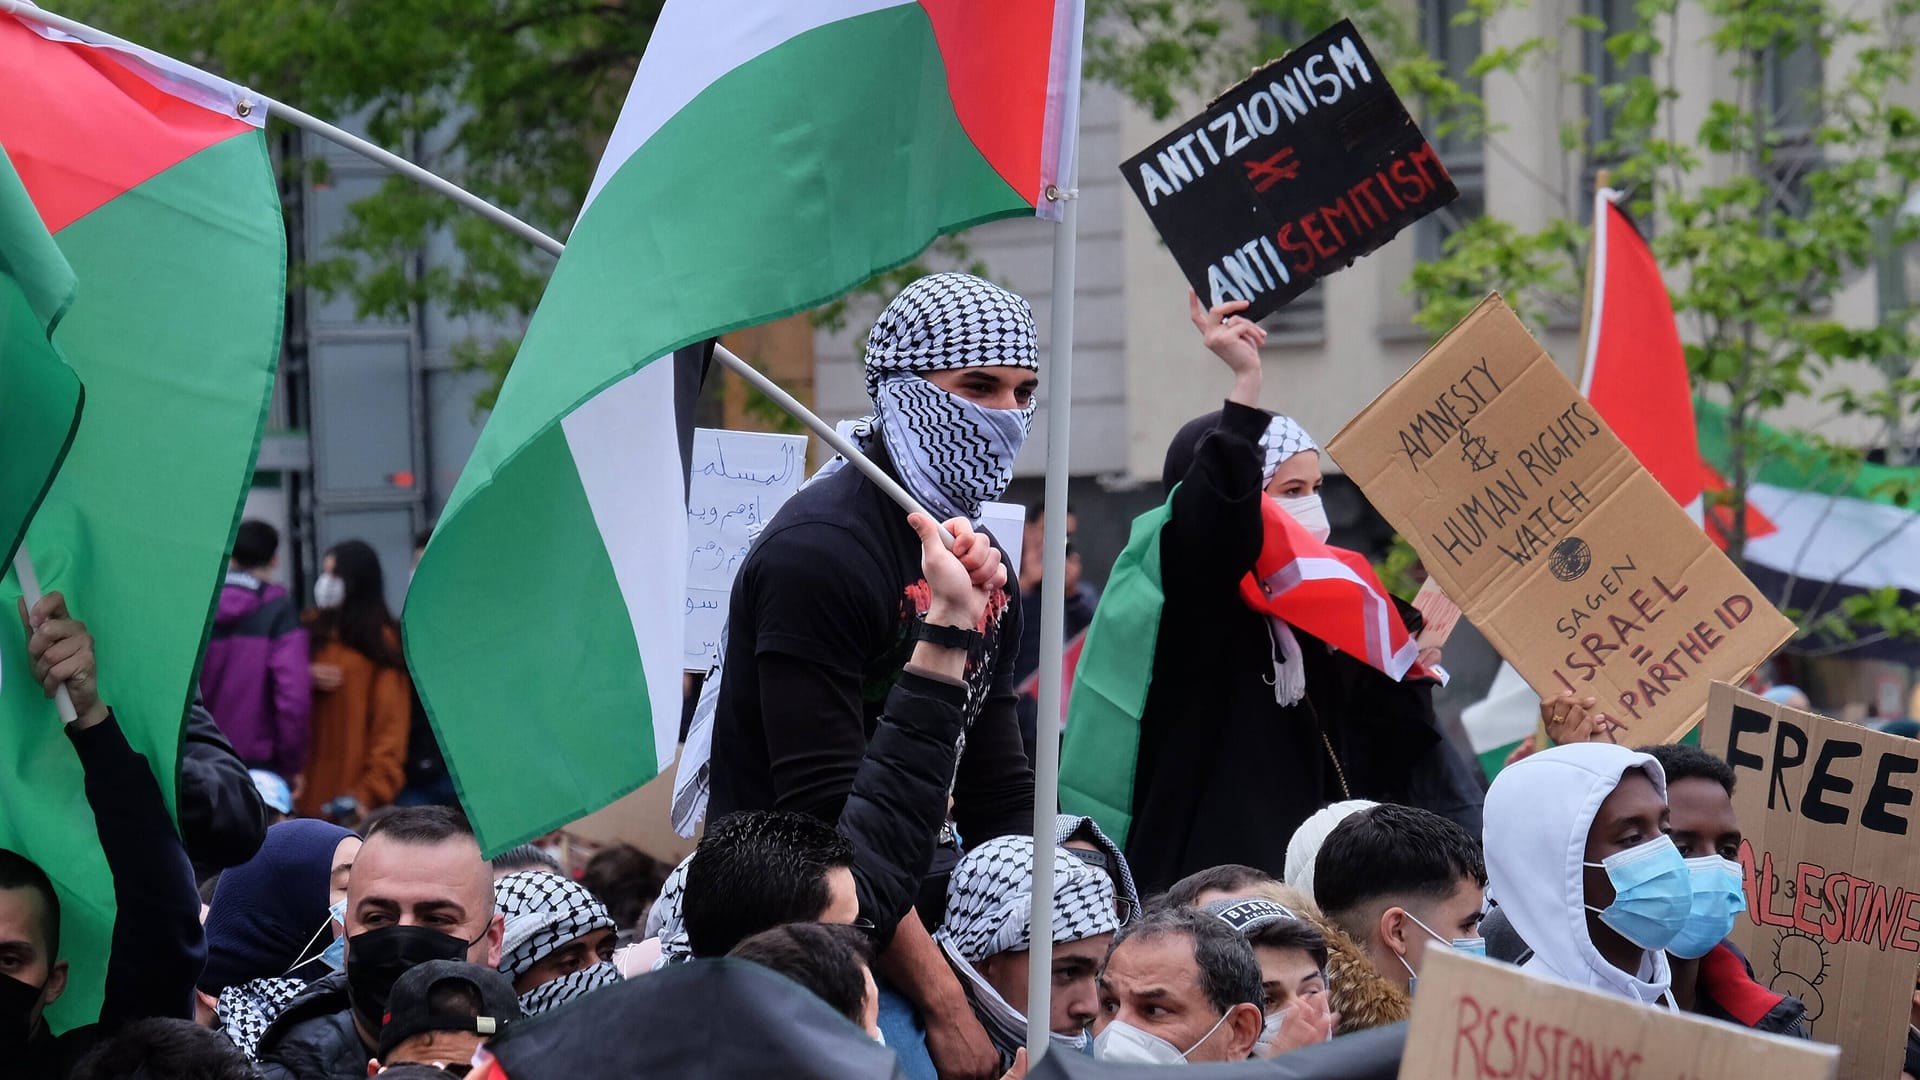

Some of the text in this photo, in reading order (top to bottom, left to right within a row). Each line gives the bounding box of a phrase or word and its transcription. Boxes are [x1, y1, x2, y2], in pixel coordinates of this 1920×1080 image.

[1139, 36, 1372, 207] ANTIZIONISM
[1399, 357, 1502, 472] AMNESTY
[1432, 402, 1599, 566] HUMAN RIGHTS
[1497, 480, 1590, 566] WATCH
[1552, 576, 1688, 694] ISRAEL
[1556, 554, 1637, 639] SAGEN
[1726, 703, 1919, 835] FREE
[1737, 839, 1920, 951] ALESTINE
